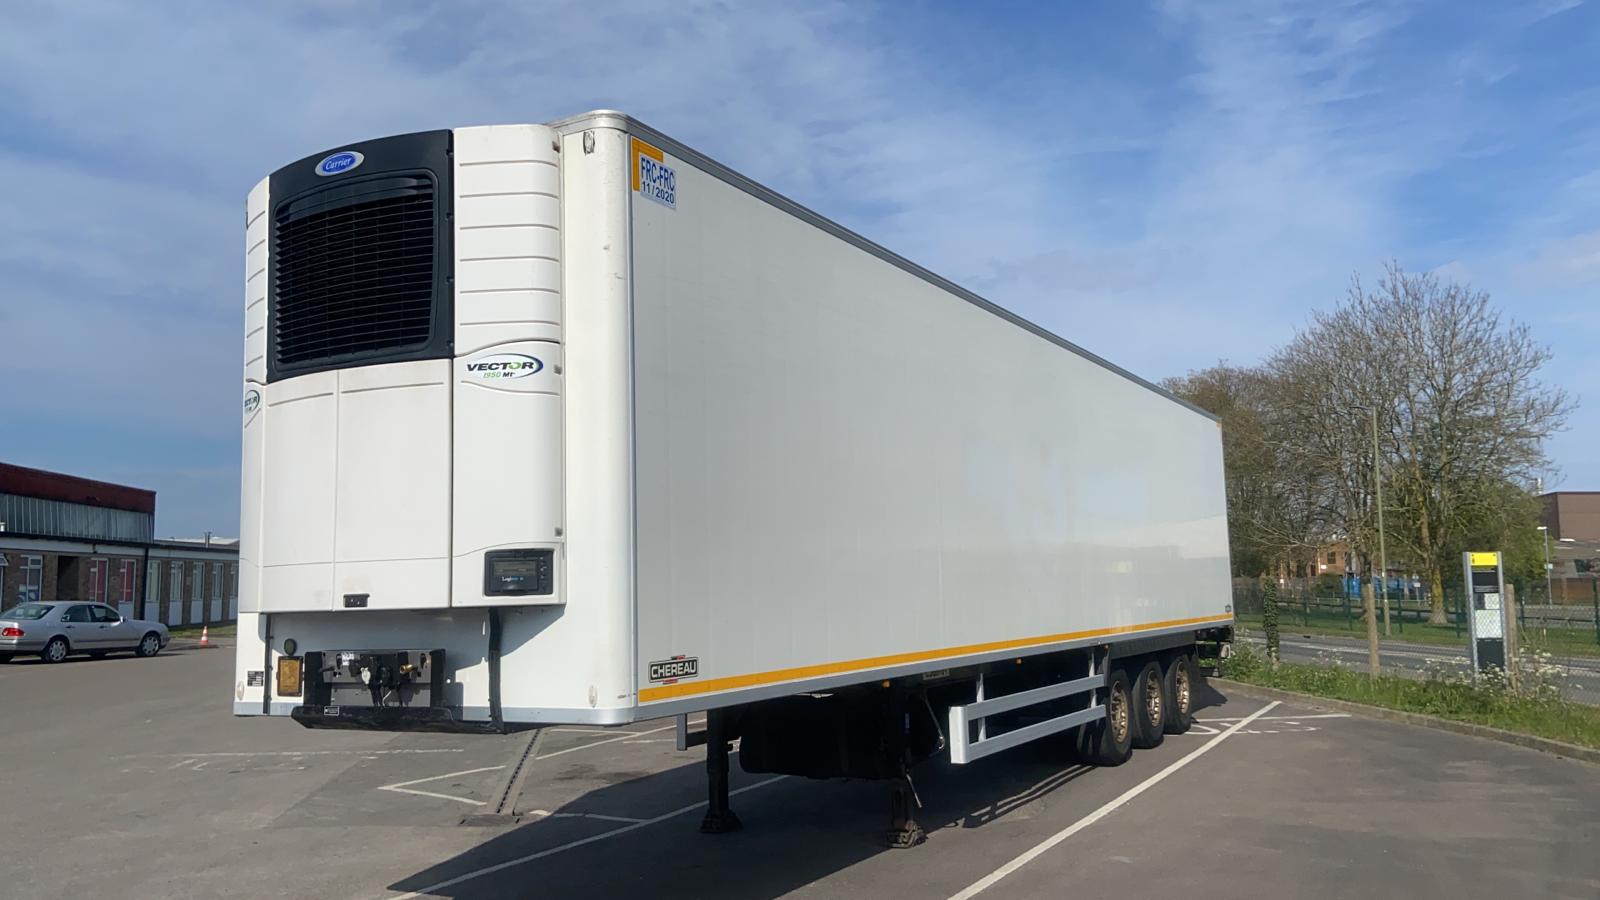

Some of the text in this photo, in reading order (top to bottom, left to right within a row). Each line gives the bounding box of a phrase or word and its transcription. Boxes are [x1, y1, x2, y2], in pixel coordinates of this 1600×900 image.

[325, 157, 351, 170] Carrier
[641, 157, 675, 192] FRC-FRC
[467, 361, 534, 371] VECTOR
[651, 660, 697, 678] CHEREAU
